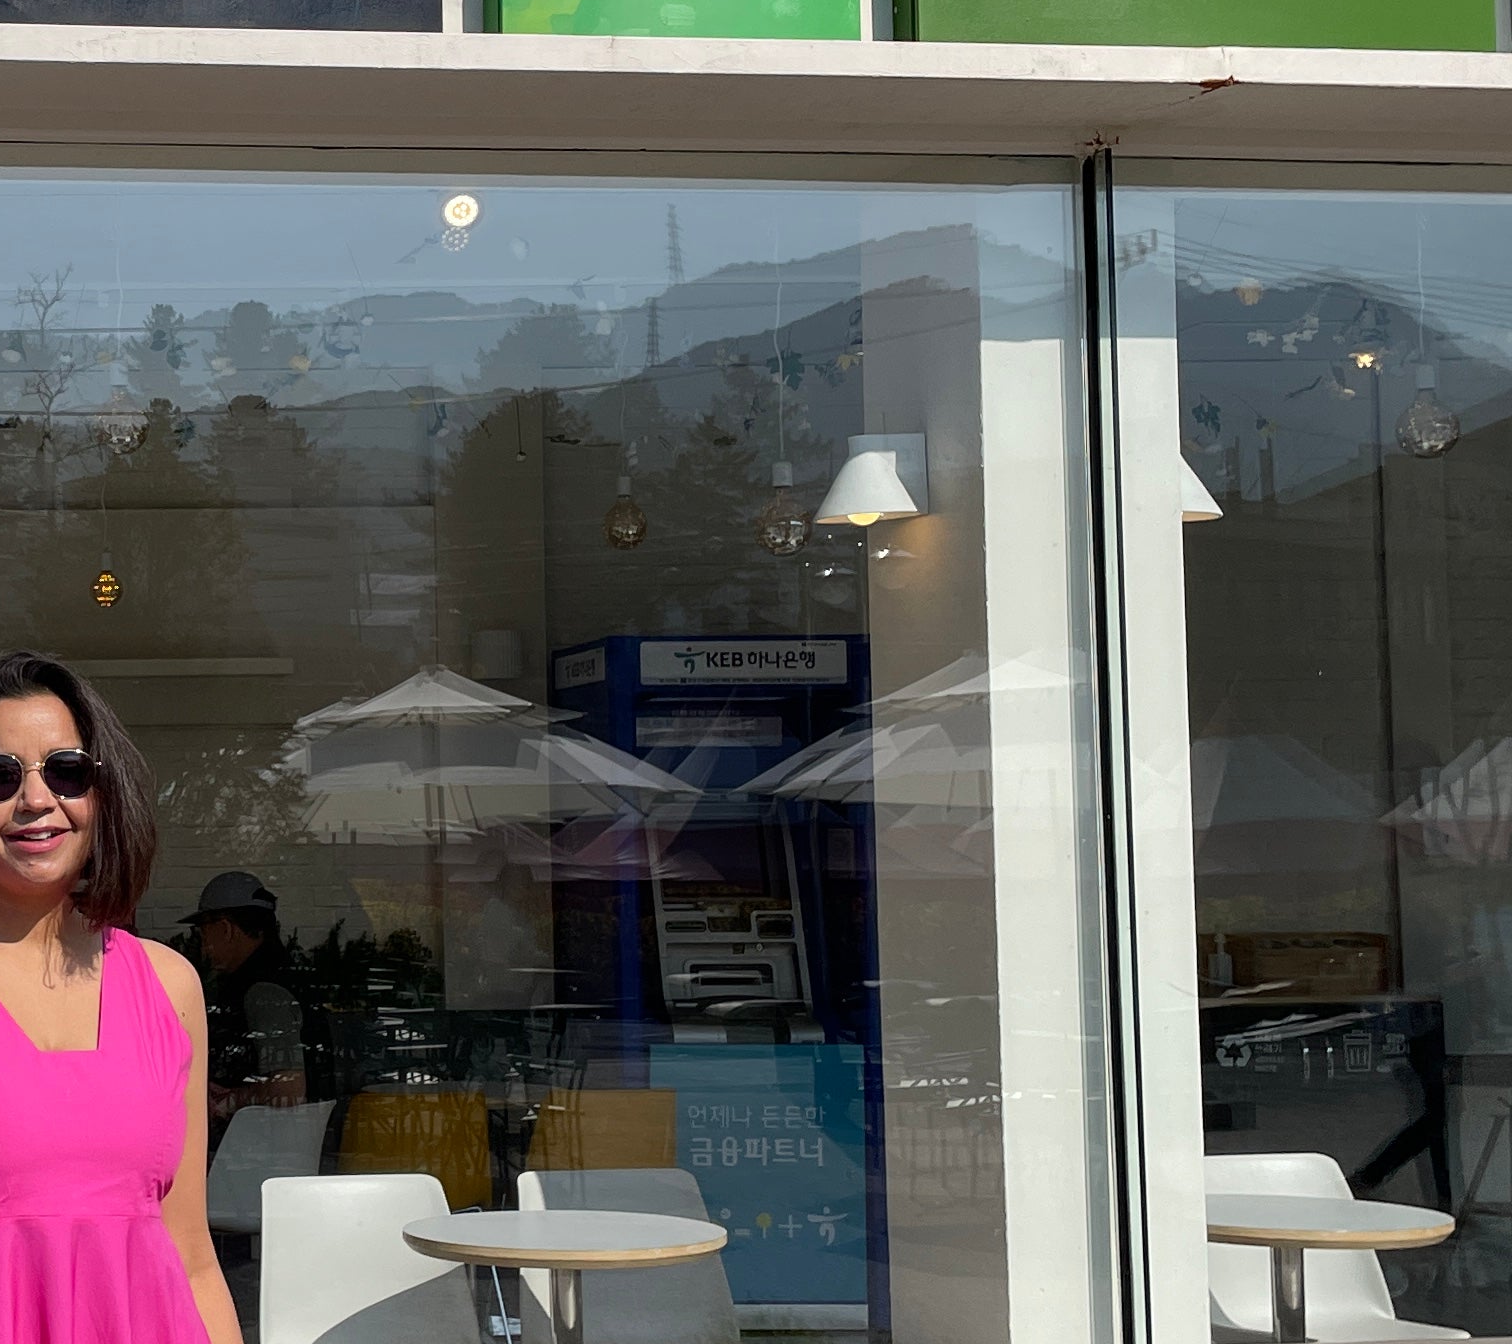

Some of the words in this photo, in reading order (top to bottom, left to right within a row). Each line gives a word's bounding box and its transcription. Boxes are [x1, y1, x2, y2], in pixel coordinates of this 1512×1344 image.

[705, 651, 744, 669] KEB
[688, 1105, 753, 1129] 언제나
[761, 1105, 827, 1129] 든든한
[690, 1136, 825, 1168] 금융파트너
